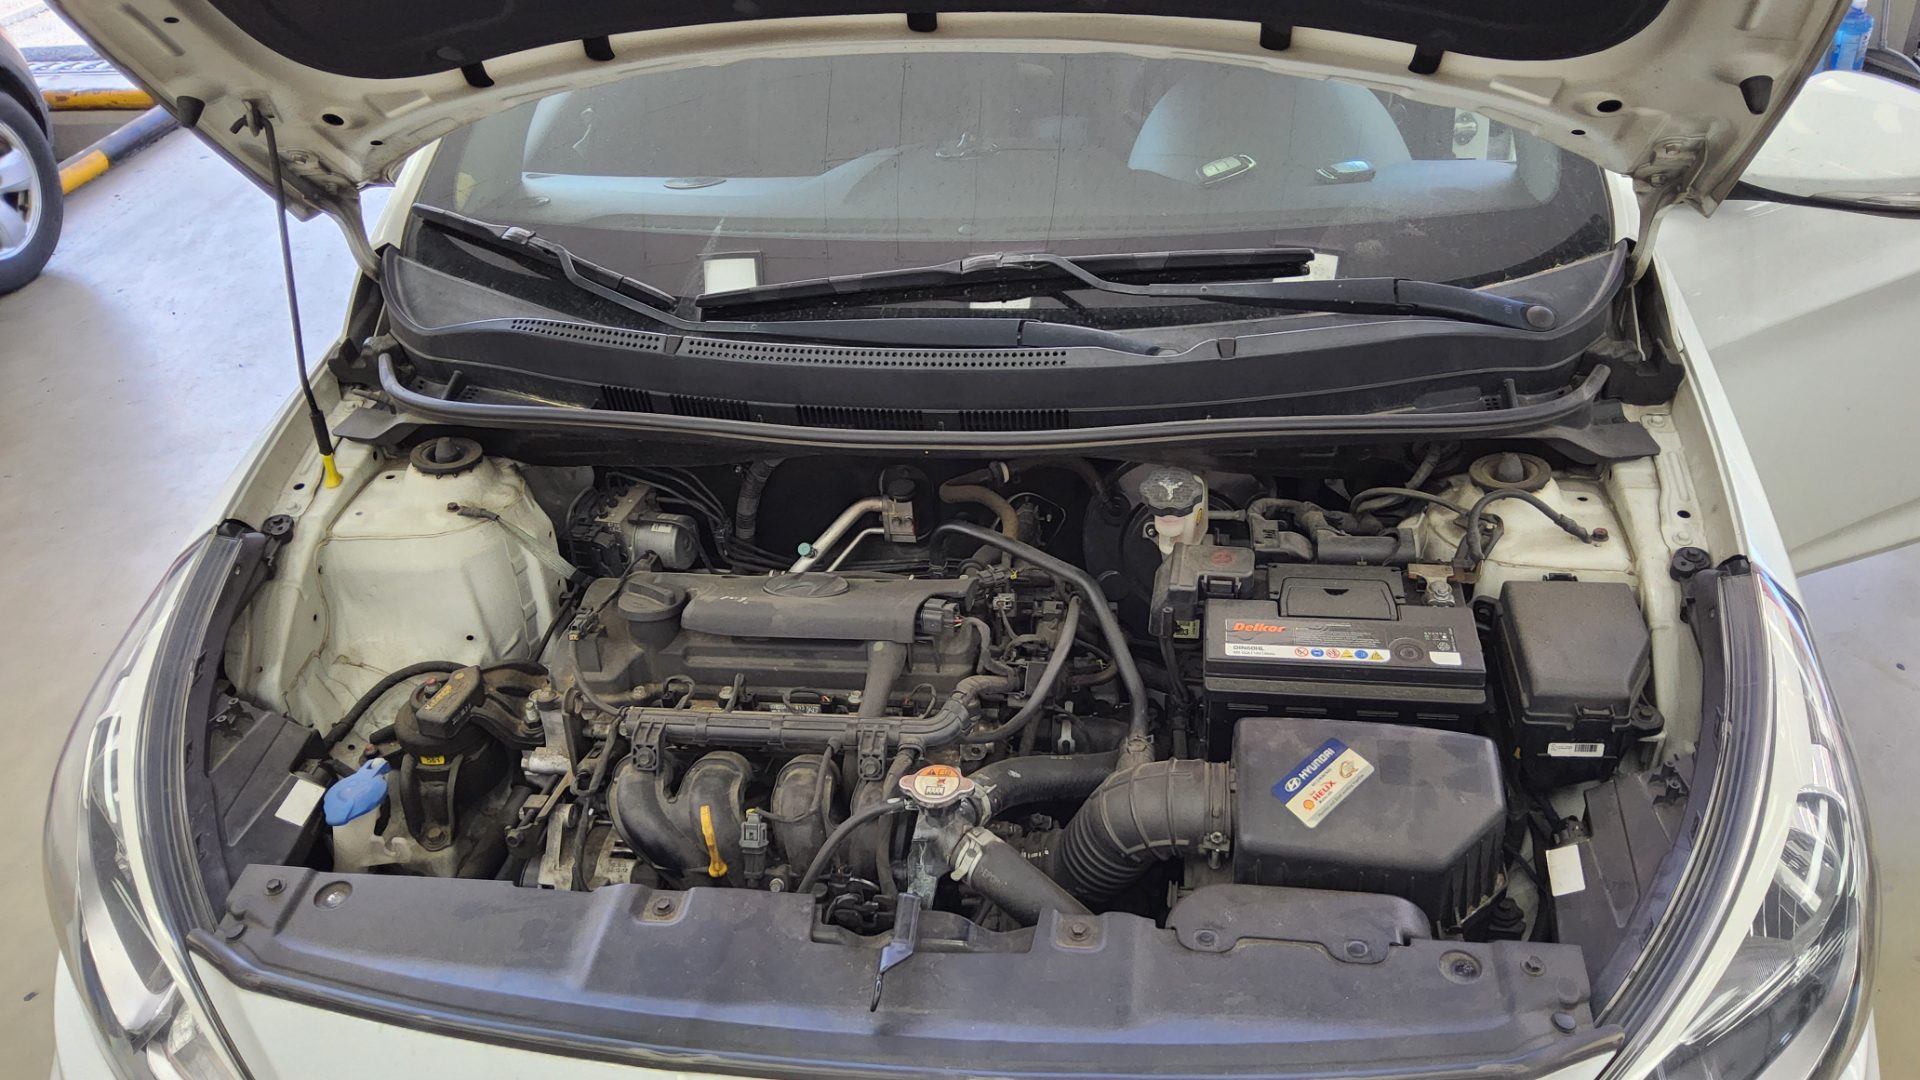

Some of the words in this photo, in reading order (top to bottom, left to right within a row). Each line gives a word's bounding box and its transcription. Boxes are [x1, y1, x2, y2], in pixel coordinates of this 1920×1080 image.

[1233, 622, 1286, 632] Delkor
[1298, 747, 1336, 780] HYUNDAI
[1312, 780, 1336, 801] HELIX
